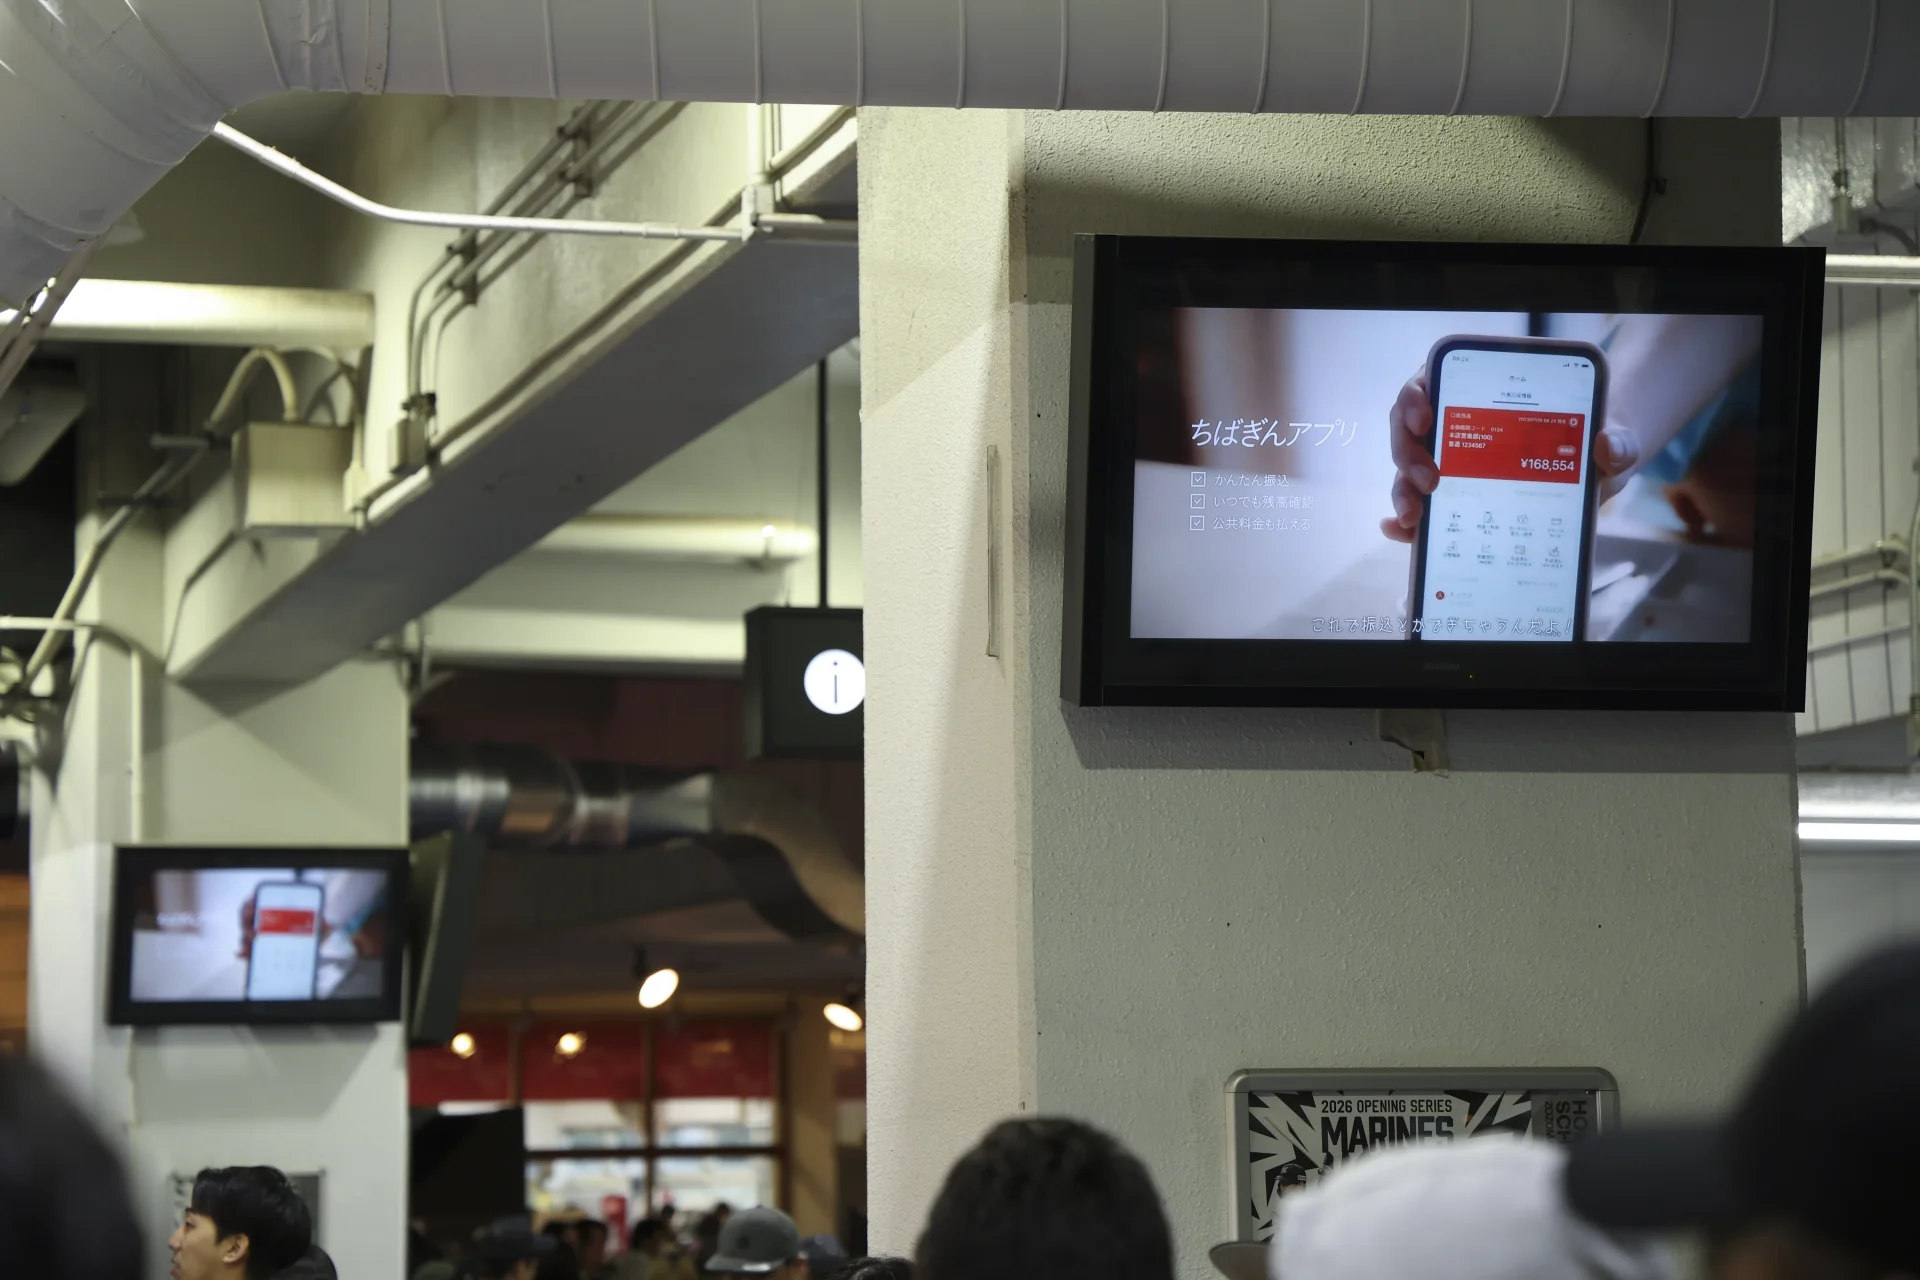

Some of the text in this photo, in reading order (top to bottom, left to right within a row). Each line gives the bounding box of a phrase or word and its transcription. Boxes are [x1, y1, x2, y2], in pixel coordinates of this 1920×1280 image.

[1191, 417, 1358, 448] ちばぎんアプリ
[1462, 441, 1486, 449] 1234567
[1520, 458, 1575, 472] ¥168,554
[1214, 473, 1290, 488] かんたん振込
[1213, 495, 1315, 509] いつでも残高確認
[1212, 517, 1312, 531] 公共料金も払える
[1321, 1099, 1453, 1113] 2026 OPENING SERIES
[1544, 1100, 1554, 1139] ZOZOM
[1555, 1100, 1572, 1144] SCH
[1321, 1115, 1454, 1153] MARINES
